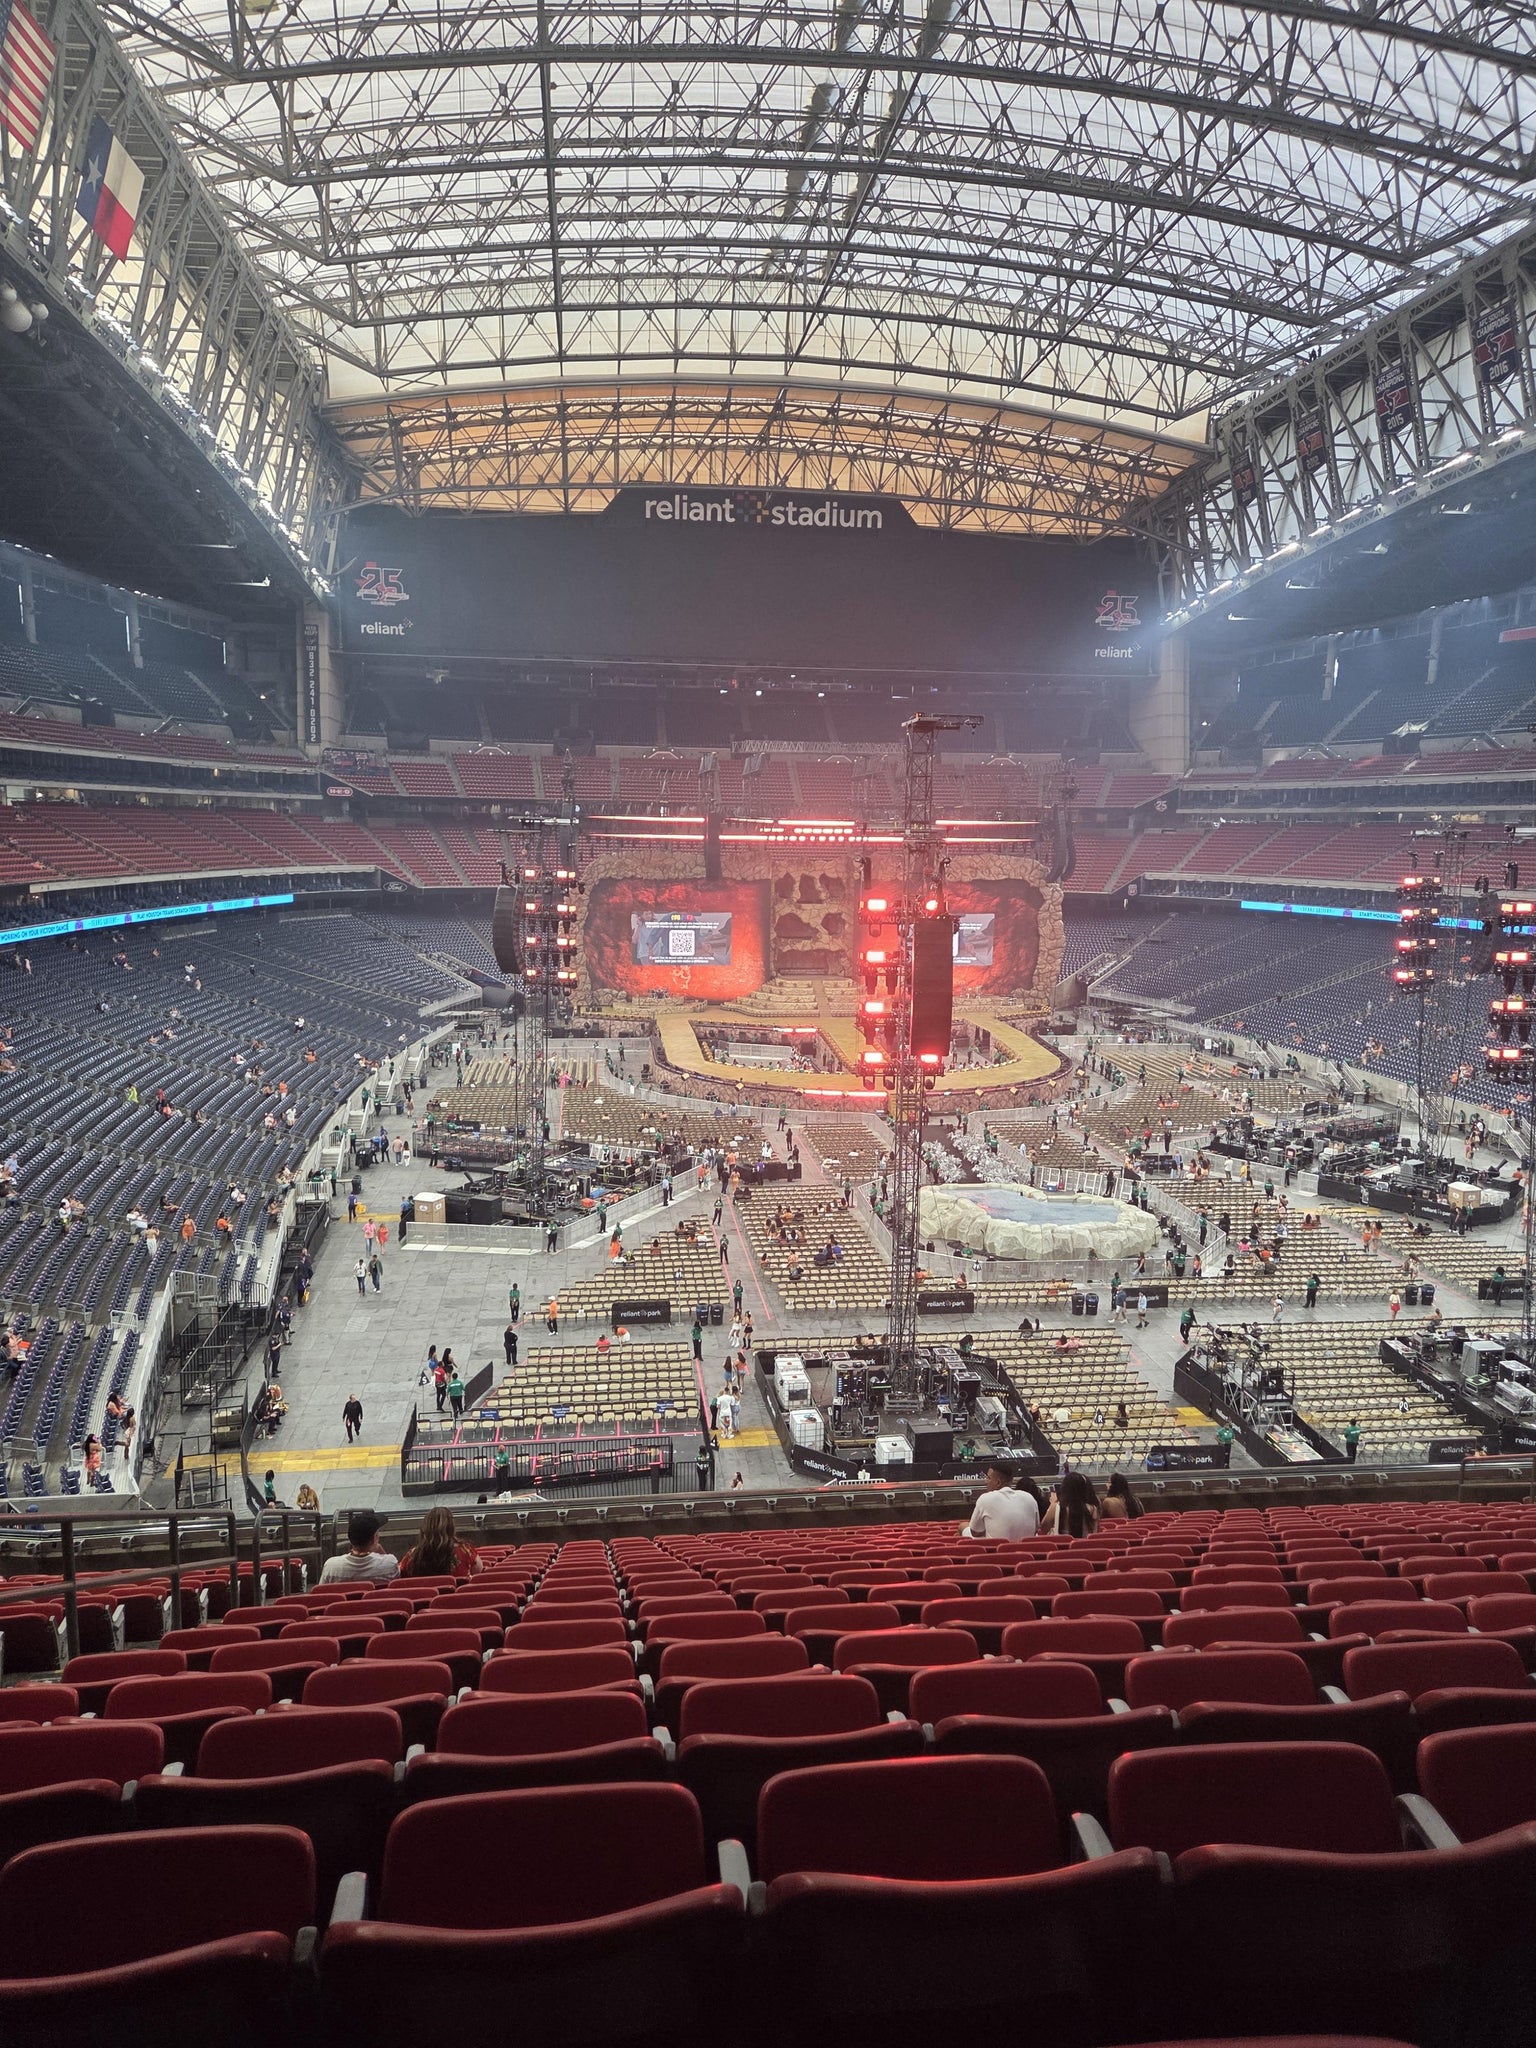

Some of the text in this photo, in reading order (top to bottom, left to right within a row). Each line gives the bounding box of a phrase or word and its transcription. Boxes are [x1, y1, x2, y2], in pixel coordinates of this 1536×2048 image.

[1476, 313, 1510, 339] CHAMPIONS
[1488, 360, 1509, 380] 2016
[1375, 373, 1405, 394] CHAMPIONS
[1386, 412, 1405, 431] 2015
[645, 494, 882, 529] reliant stadium
[361, 567, 404, 601] 25
[1100, 595, 1139, 626] 25
[361, 622, 405, 635] reliant
[1095, 646, 1133, 658] reliant
[647, 1309, 661, 1318] park
[803, 1459, 847, 1479] reliant park
[1195, 1455, 1213, 1465] park
[953, 1471, 979, 1481] reliant
